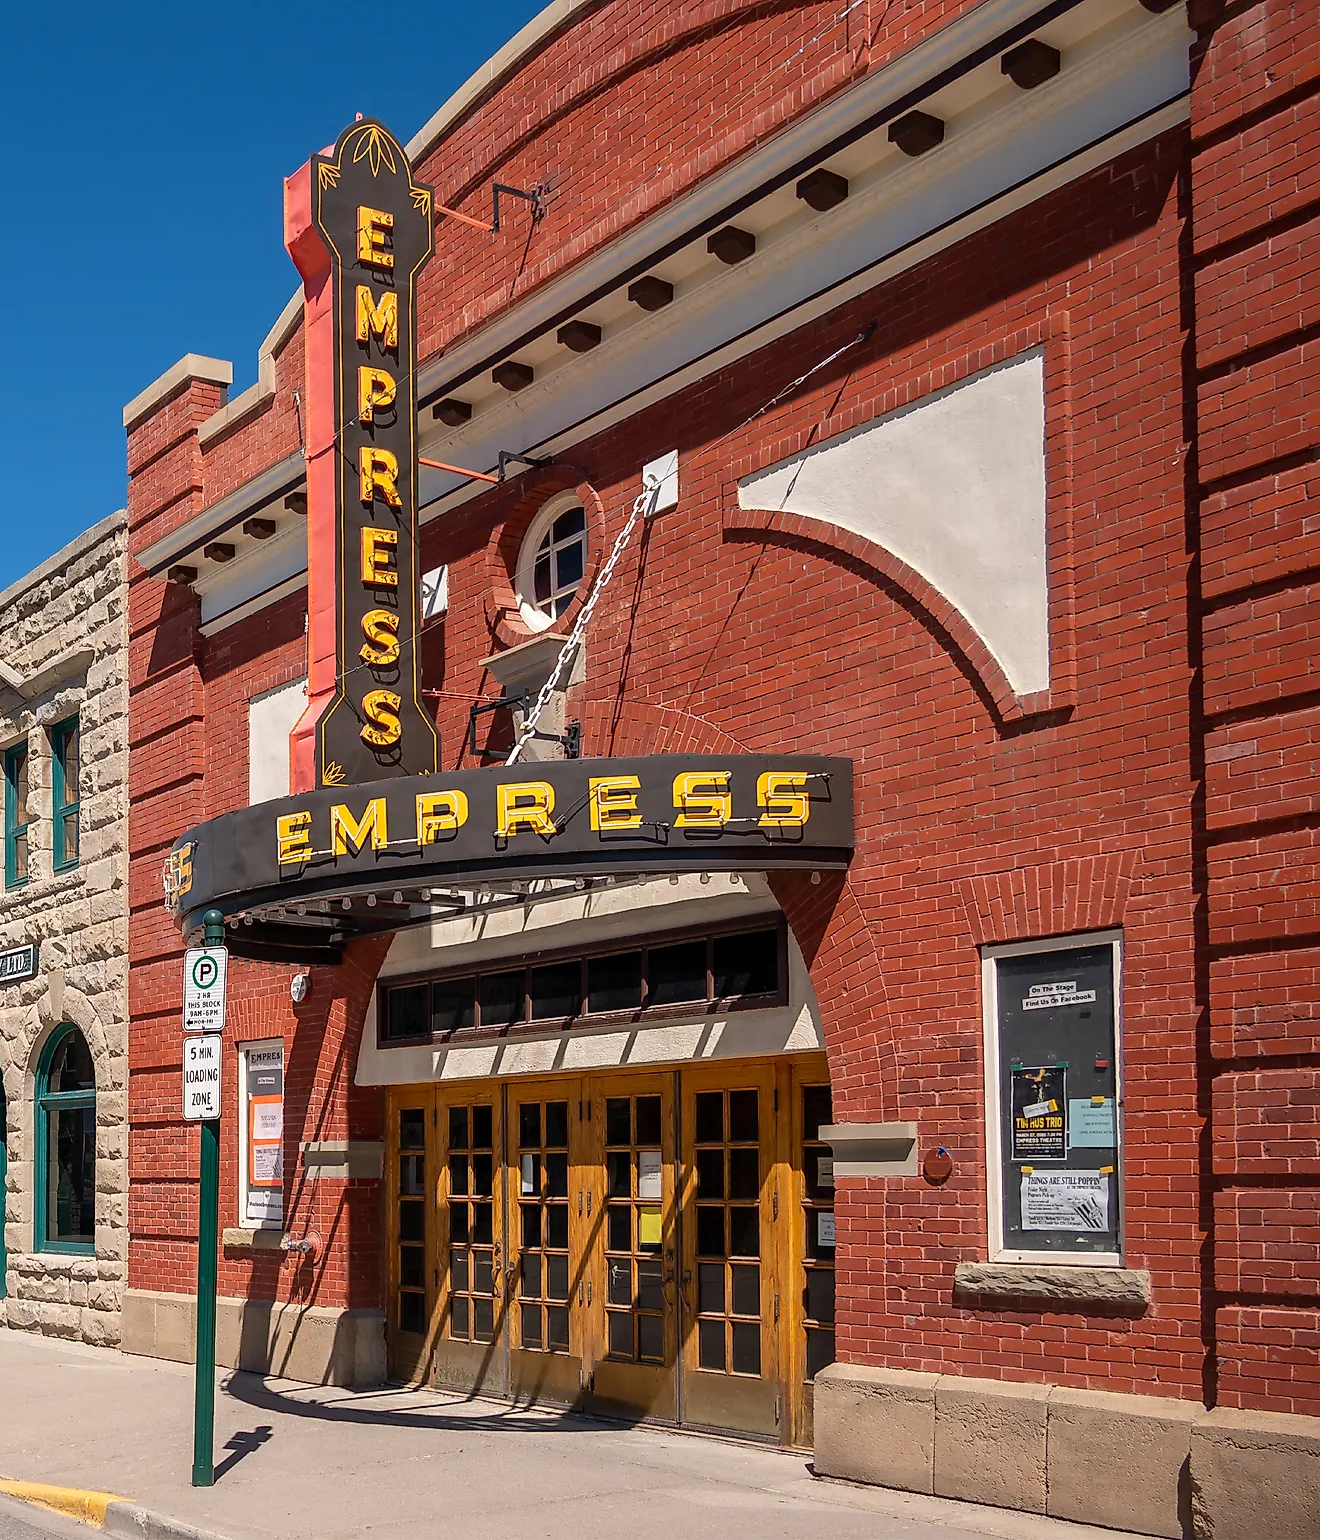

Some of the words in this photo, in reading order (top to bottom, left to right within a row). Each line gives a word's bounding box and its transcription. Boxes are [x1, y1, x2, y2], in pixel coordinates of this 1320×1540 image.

[355, 204, 402, 747] EMPRESS
[276, 770, 811, 866] EMPRESS
[6, 953, 26, 973] LTD.
[200, 963, 212, 981] P
[1042, 985, 1054, 993] The
[1055, 983, 1075, 992] Stage
[202, 991, 211, 999] HR
[1060, 993, 1092, 1003] Facebook
[188, 1001, 201, 1009] THIS
[202, 1000, 221, 1009] BLOCK
[190, 1046, 197, 1060] 5
[198, 1046, 214, 1060] MIN.
[250, 1051, 282, 1064] EMPRES
[186, 1068, 218, 1084] LOADING
[191, 1092, 212, 1106] ZONE
[1045, 1117, 1063, 1128] TRIO
[1028, 1176, 1048, 1185] THINGS
[1049, 1176, 1061, 1185] ARE
[1061, 1176, 1077, 1185] STILL
